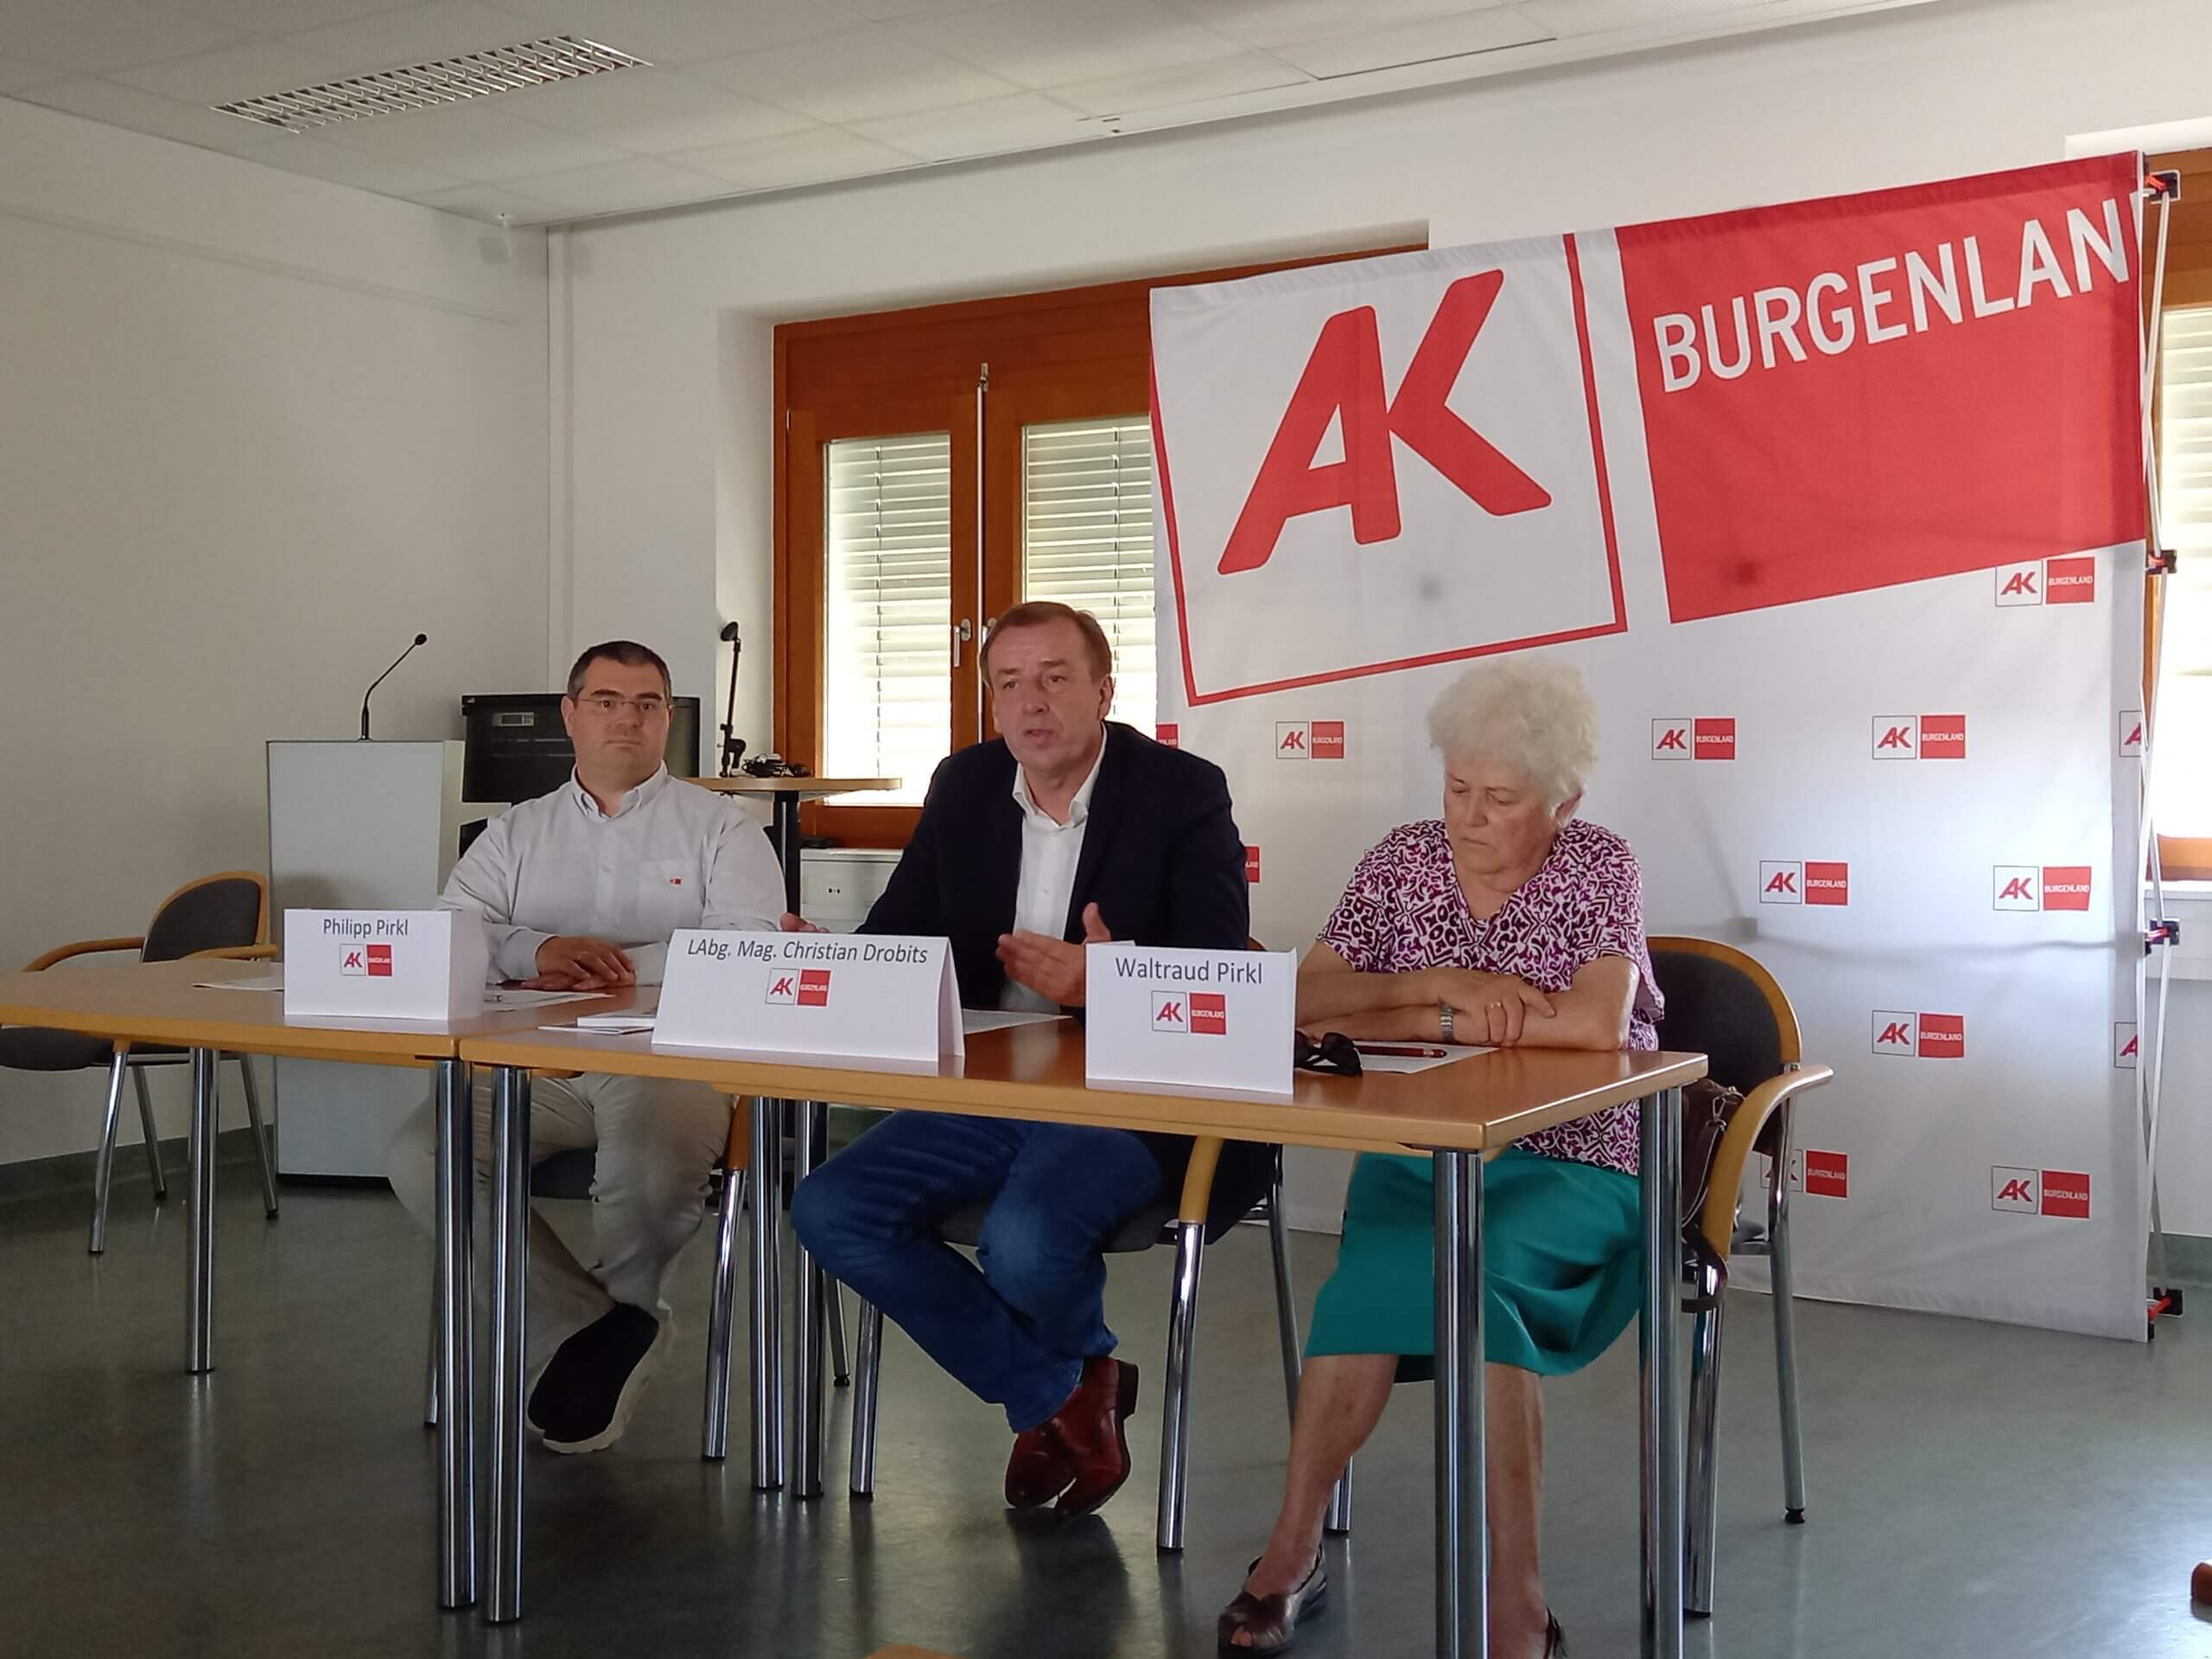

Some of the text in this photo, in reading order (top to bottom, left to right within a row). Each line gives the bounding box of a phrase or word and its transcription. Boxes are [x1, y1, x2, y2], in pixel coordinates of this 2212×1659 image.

[1652, 189, 2141, 393] BURGENLAN
[1217, 268, 1552, 575] AK
[2000, 571, 2037, 595] AK
[1281, 731, 1306, 750] AK
[1656, 729, 1688, 750] AK
[1877, 727, 1912, 748] AK
[1764, 872, 1797, 893] AK
[1999, 878, 2033, 899] AK
[323, 918, 409, 939] Philipp Pirkl
[344, 951, 363, 968] AK
[688, 938, 928, 963] LAbg. Mag. Christian Drobits
[1116, 957, 1262, 984] Waltraud Pirkl
[770, 977, 793, 995] AK
[1156, 1001, 1184, 1023] AK
[1877, 1022, 1910, 1046] AK
[1997, 1179, 2033, 1202] AK
